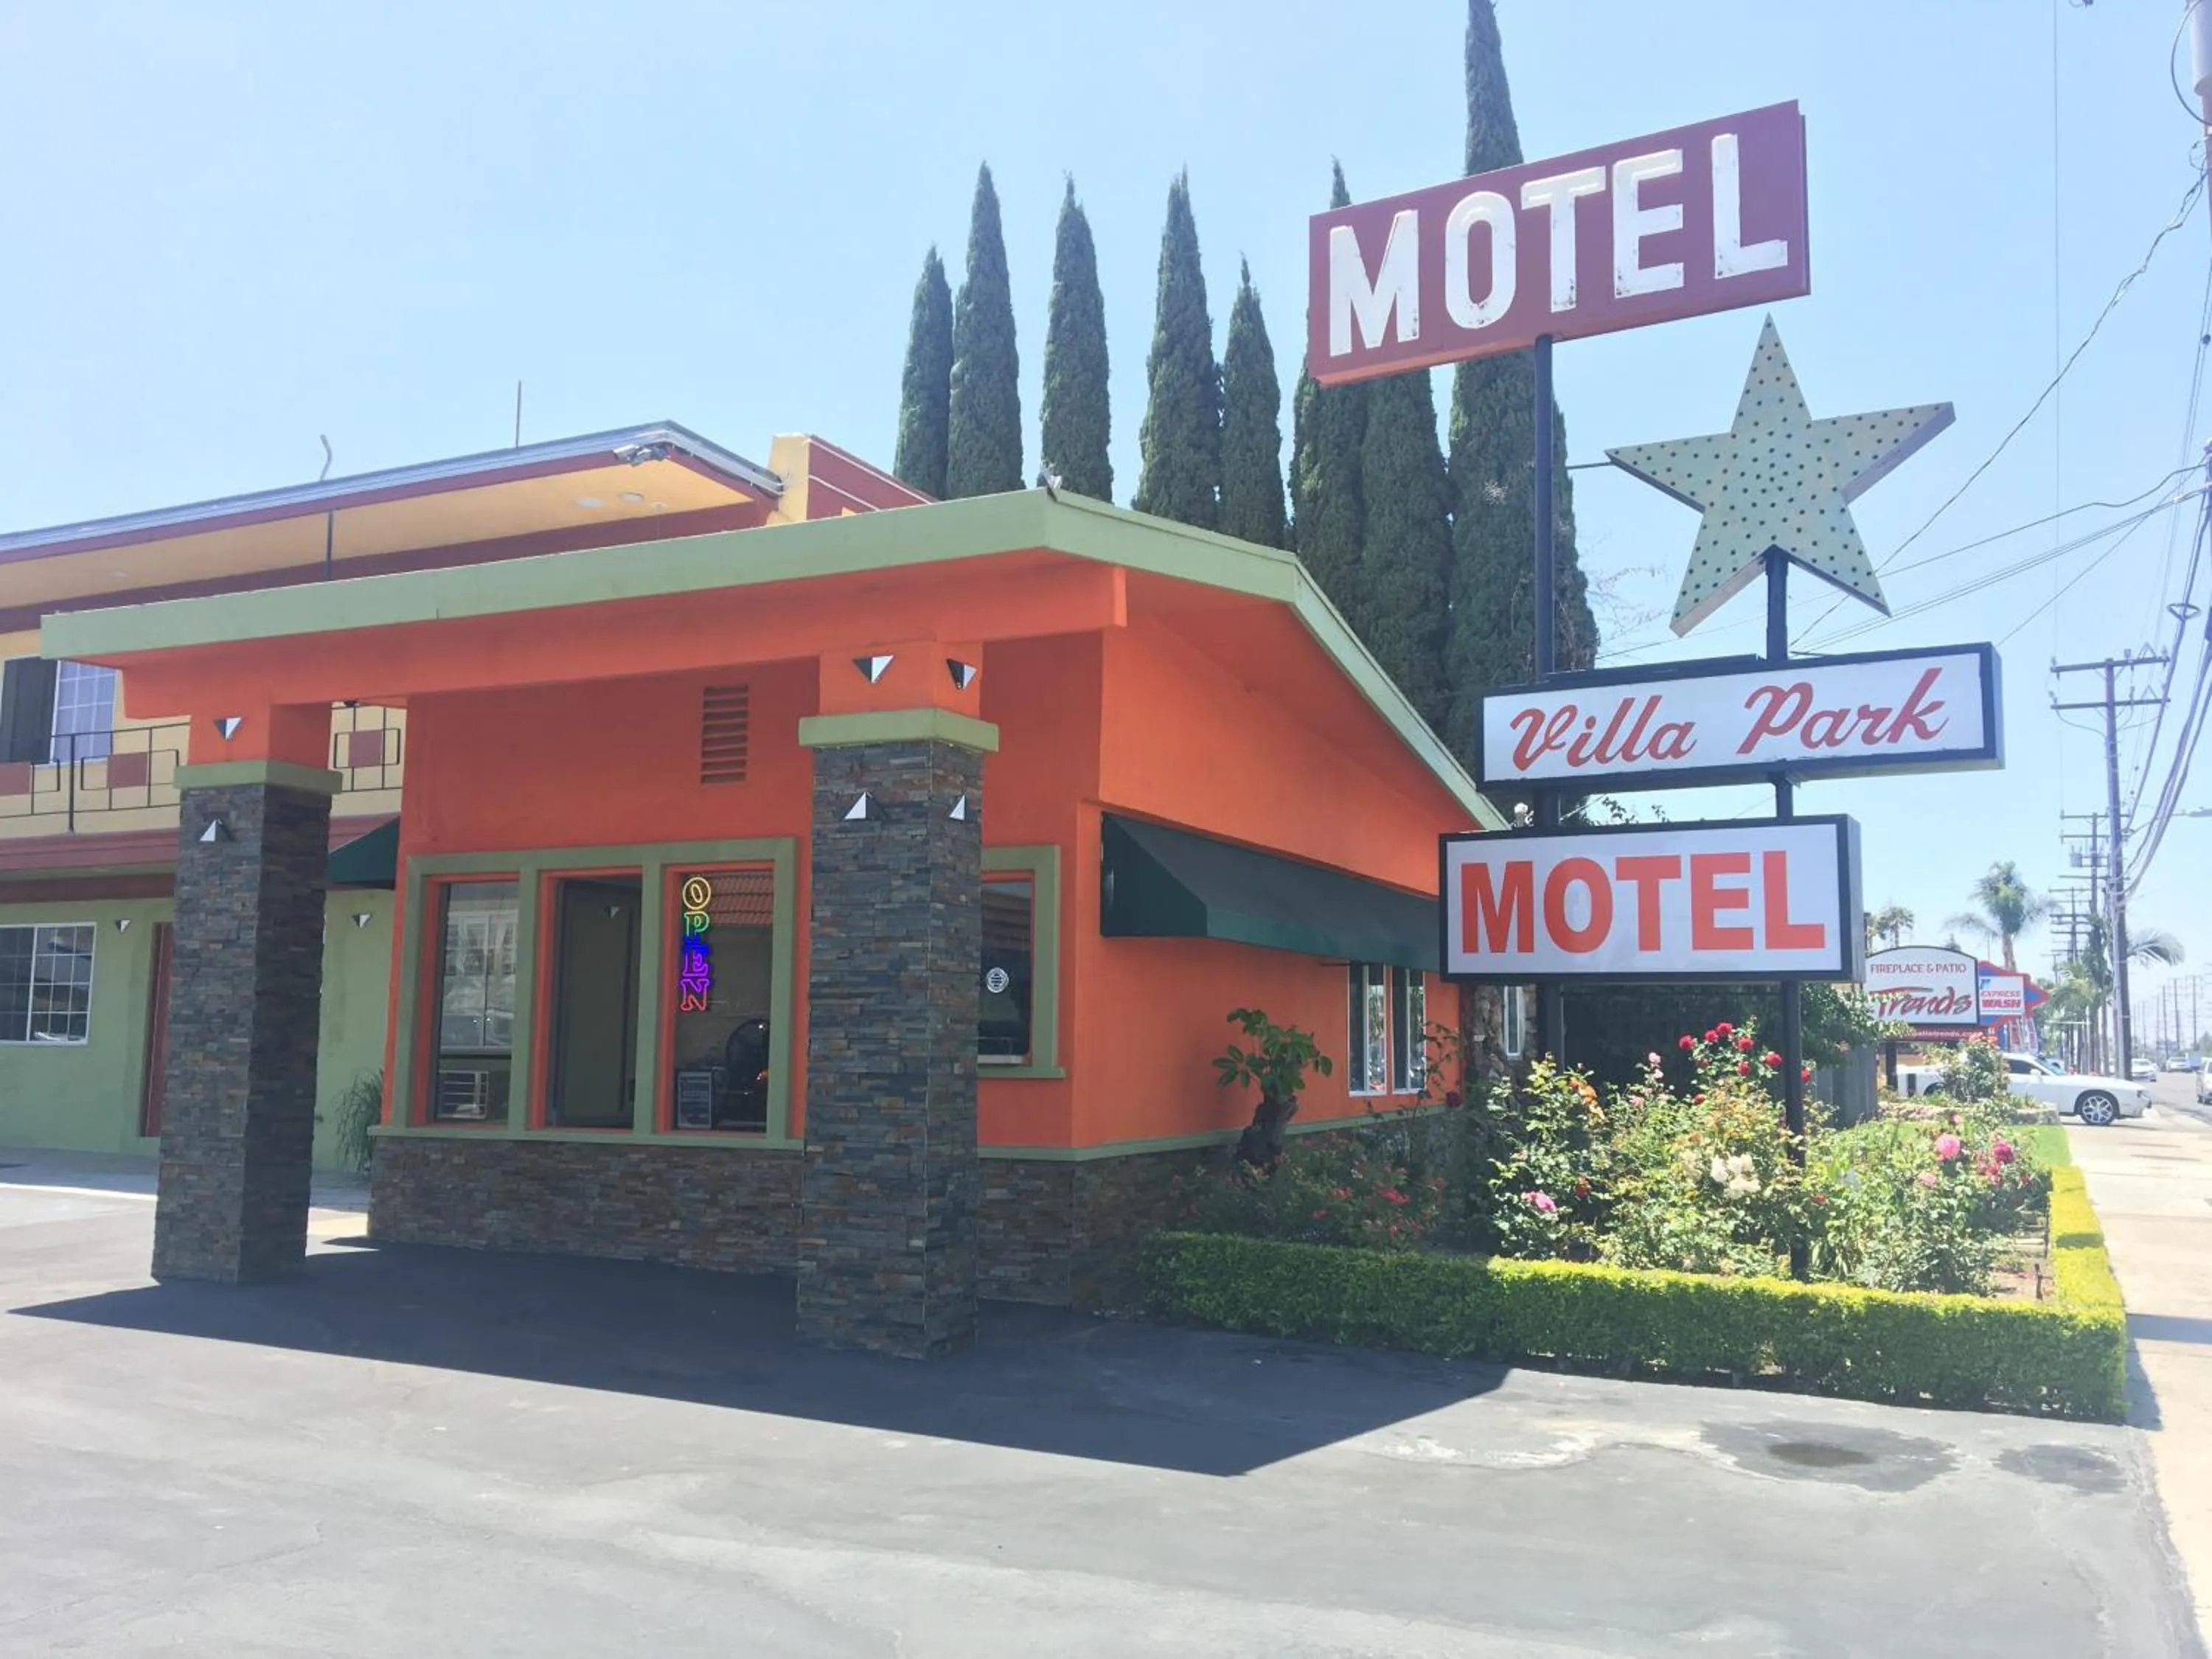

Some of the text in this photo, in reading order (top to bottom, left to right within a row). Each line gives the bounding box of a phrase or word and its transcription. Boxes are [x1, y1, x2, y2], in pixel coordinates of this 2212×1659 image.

[1329, 133, 1788, 358] MOTEL
[1509, 667, 1950, 772] Villa Park
[680, 876, 712, 1012] OPEN
[1461, 850, 1826, 954] MOTEL
[1869, 986, 1972, 1017] Trends
[1871, 963, 1966, 973] FIREPLACE & PATIO
[1981, 999, 2021, 1008] WASH
